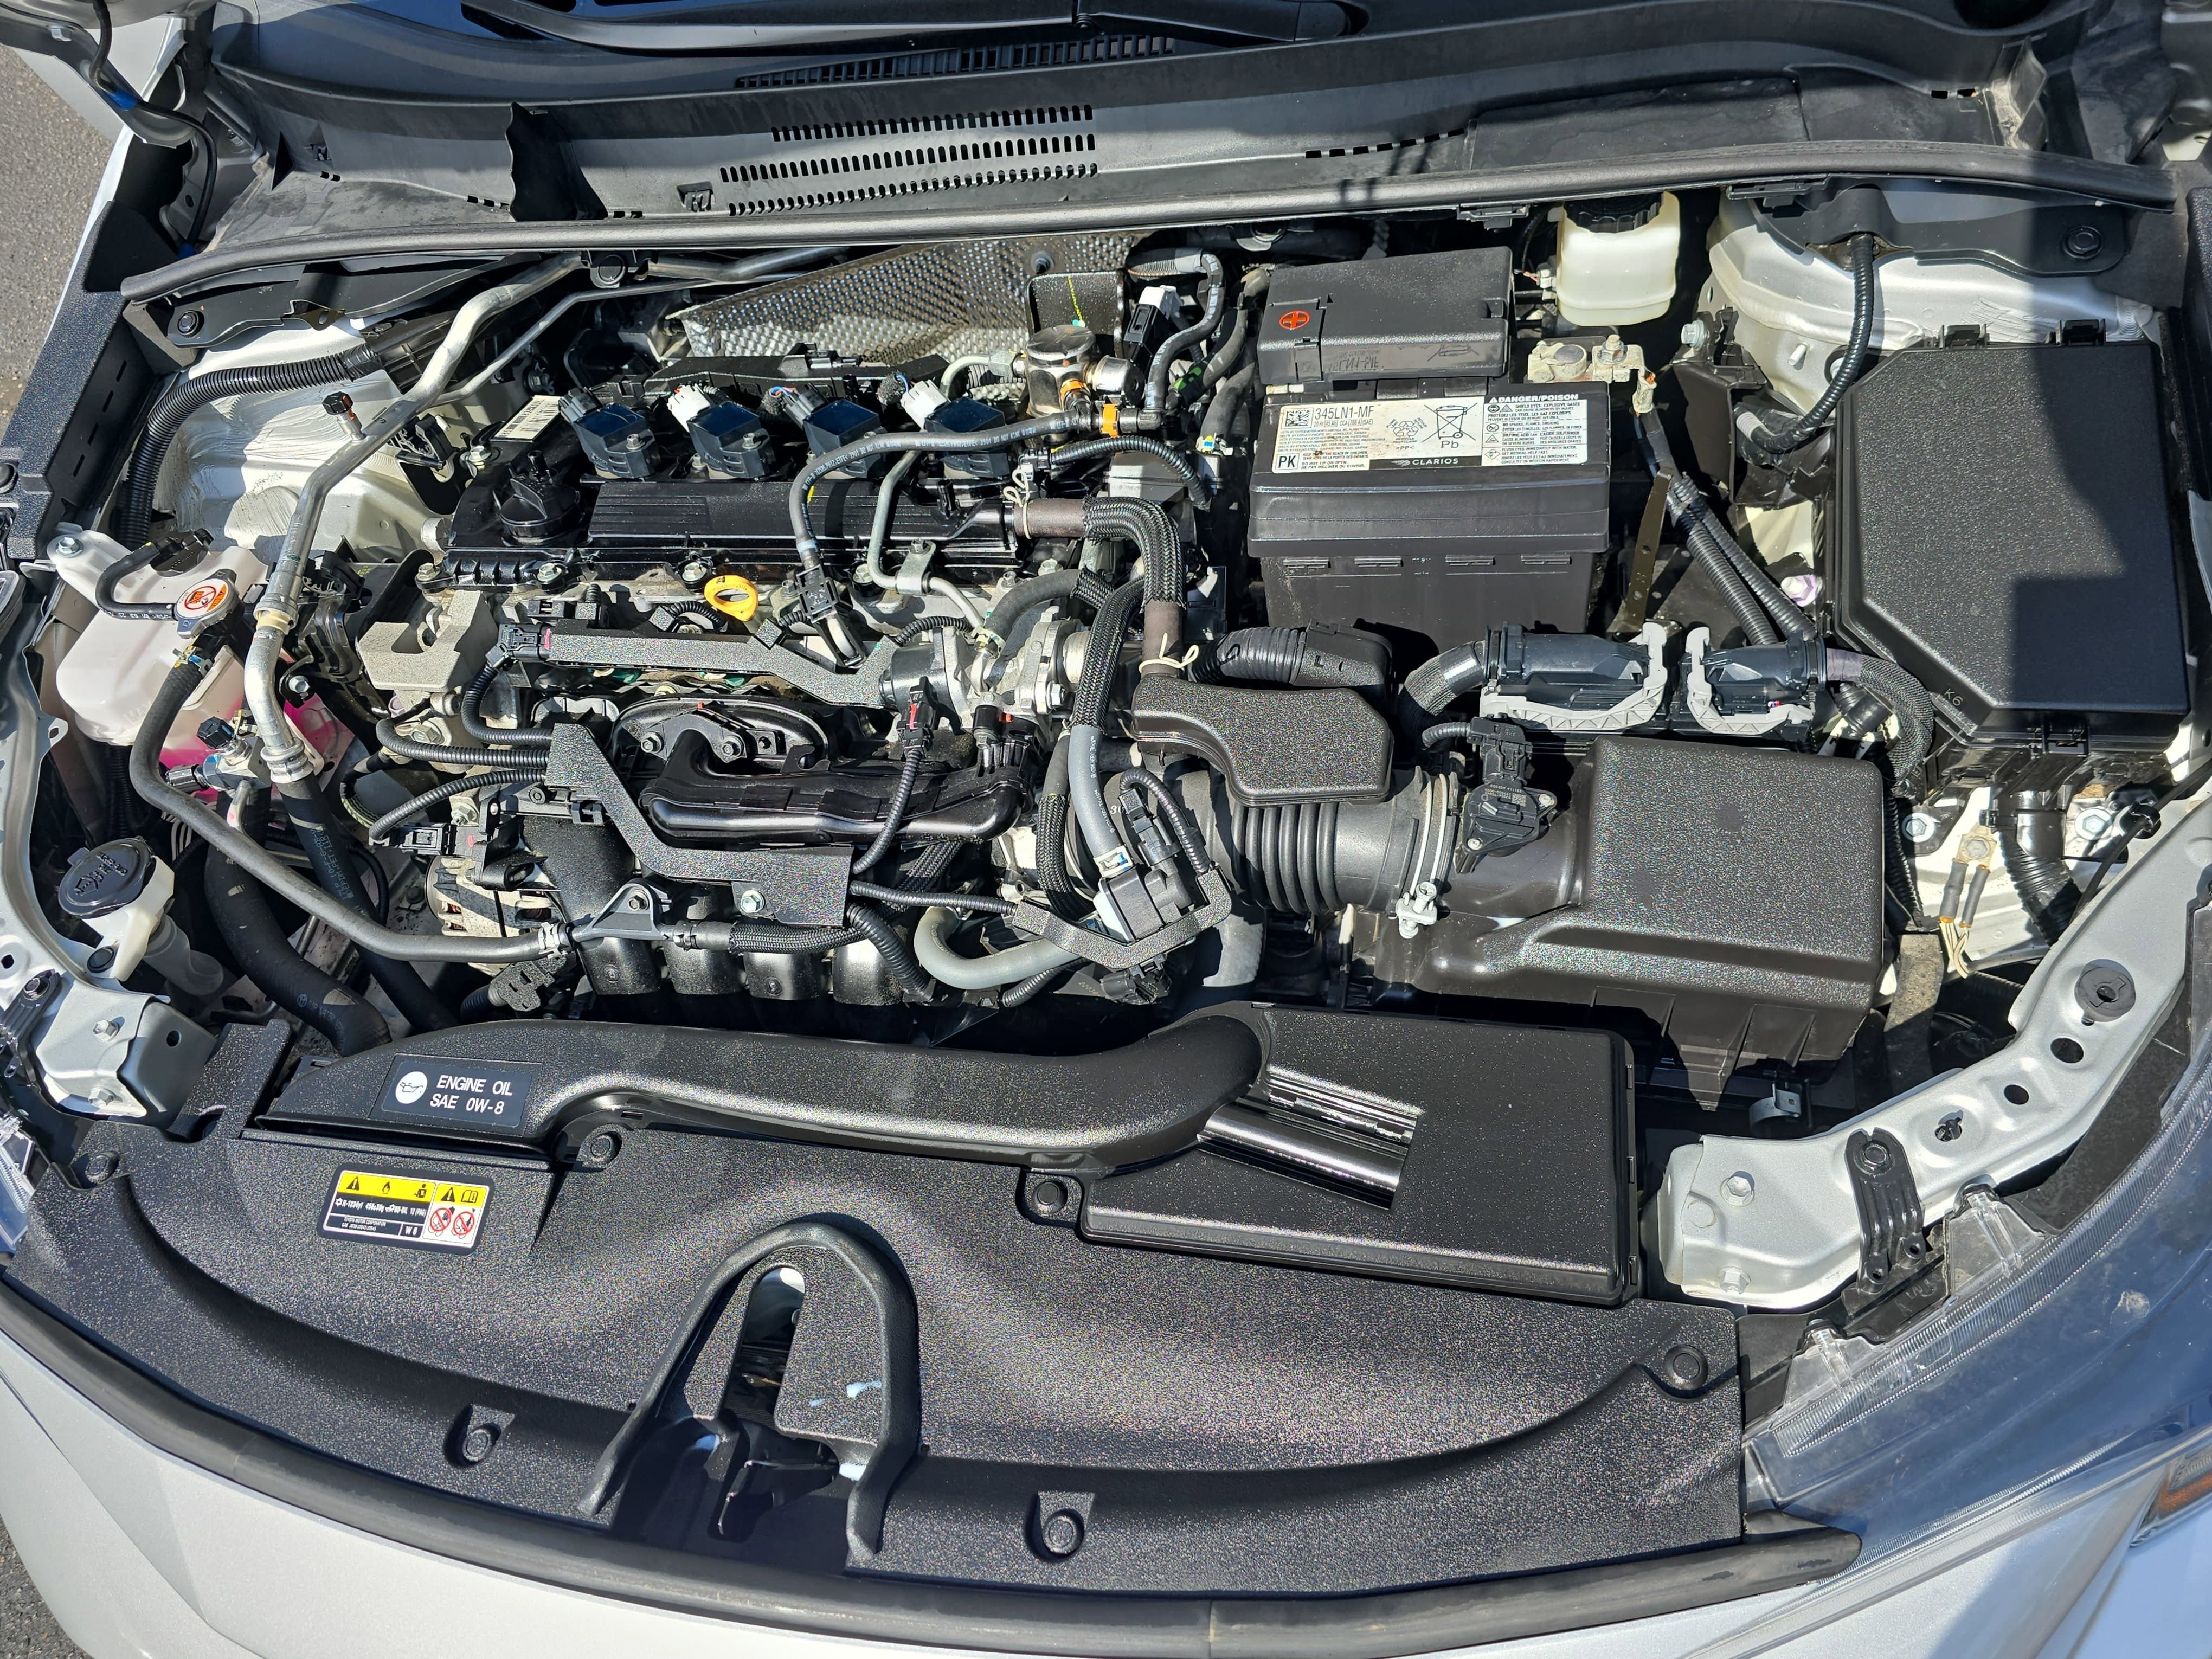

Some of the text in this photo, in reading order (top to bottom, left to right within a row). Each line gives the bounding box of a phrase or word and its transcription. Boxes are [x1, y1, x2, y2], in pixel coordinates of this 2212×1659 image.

[1498, 394, 1579, 403] DANGER/POISON
[1315, 406, 1374, 420] 345LN1-MF
[1441, 440, 1459, 448] Pb
[1278, 455, 1296, 468] PK
[1944, 688, 1963, 706] K6
[436, 1075, 513, 1096] ENGINE OIL
[429, 1094, 505, 1115] SAE 0W-8
[405, 1226, 412, 1235] W
